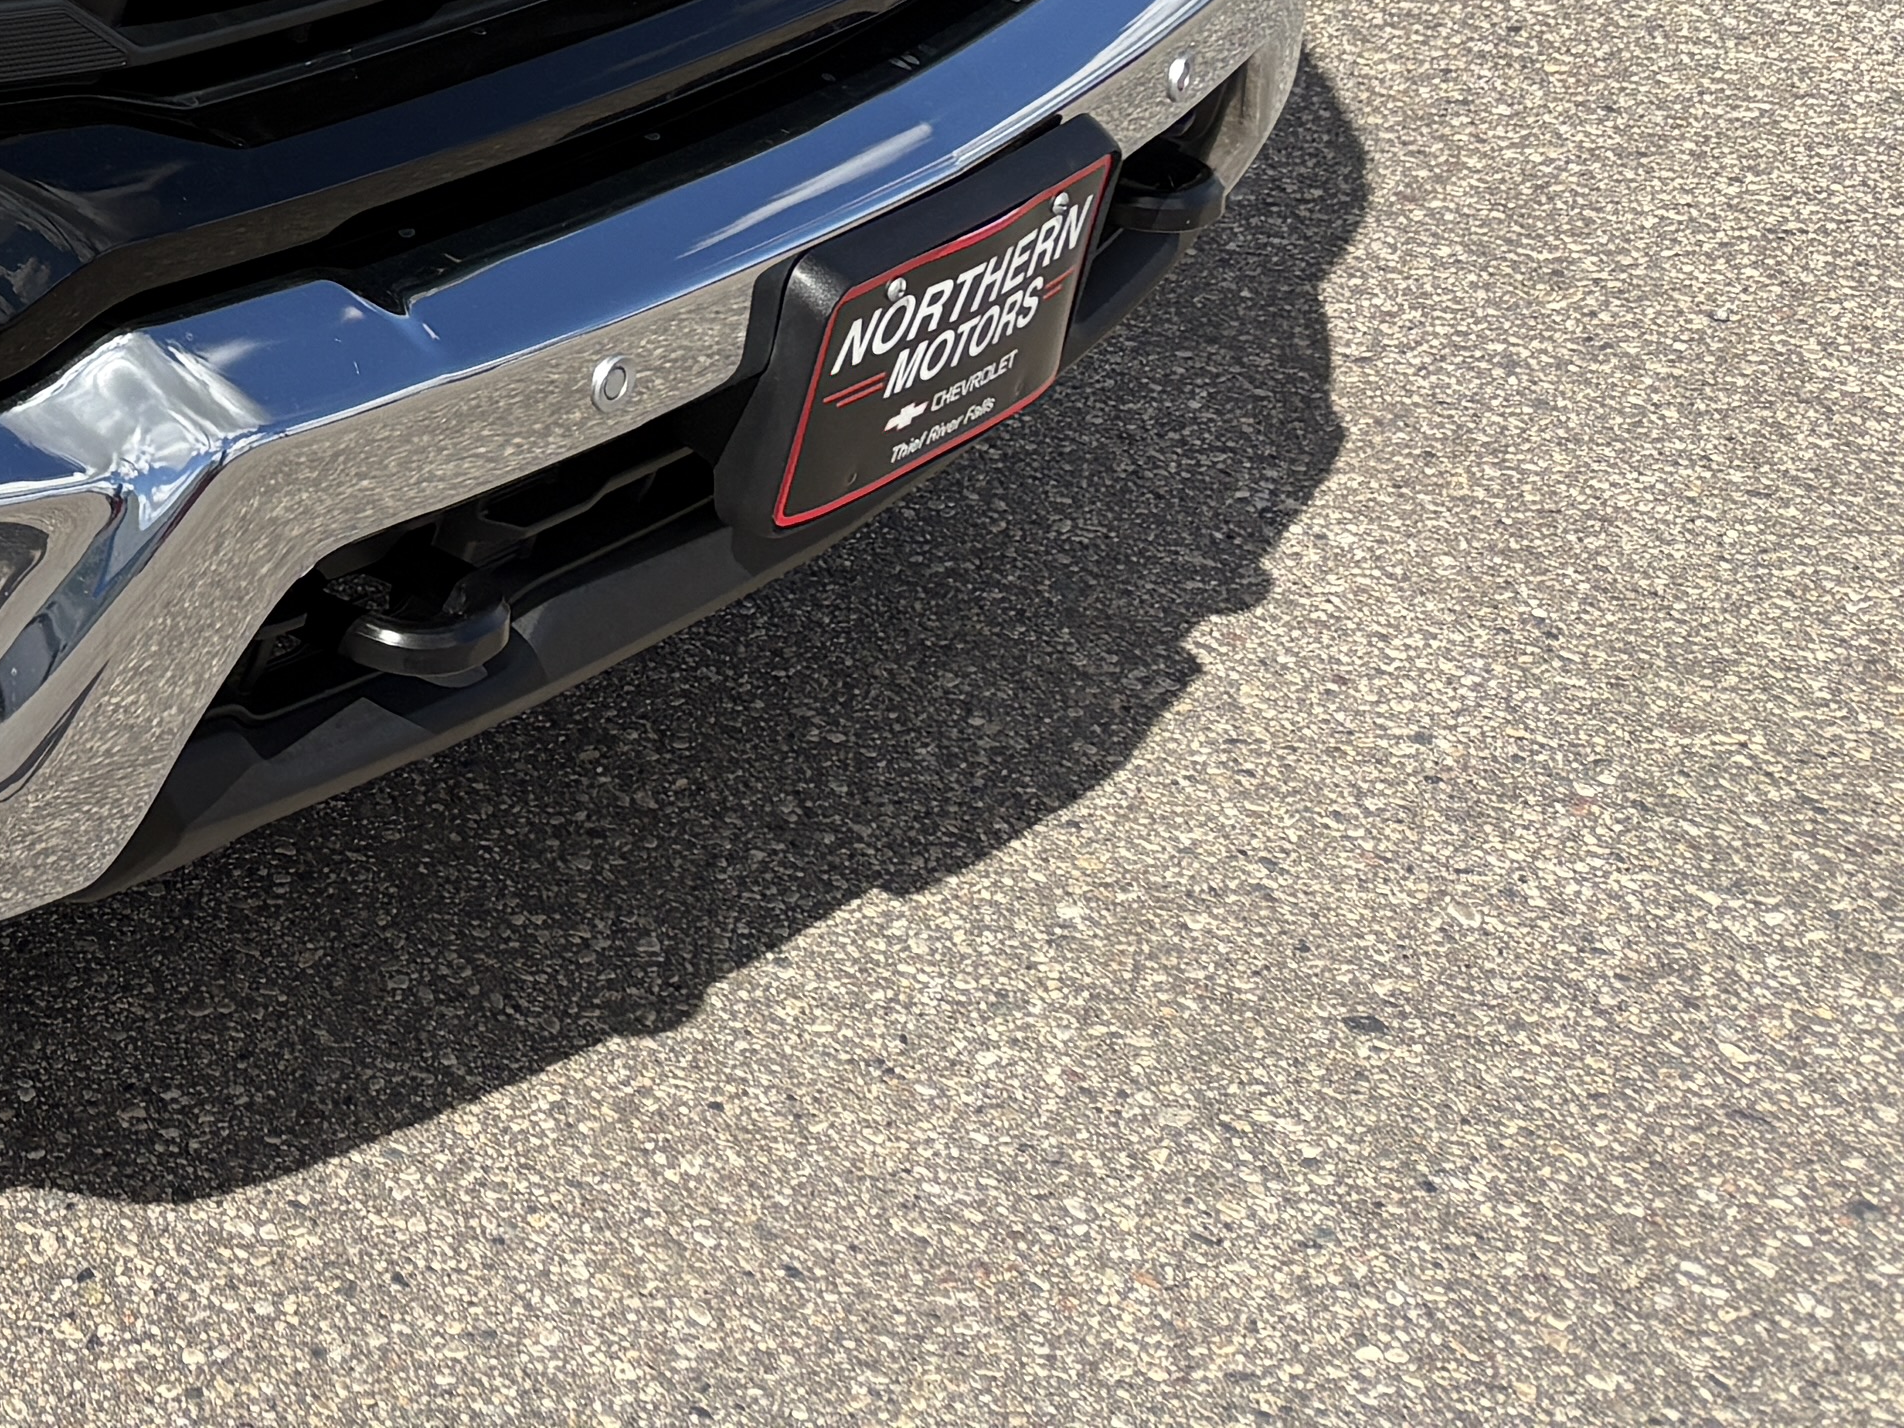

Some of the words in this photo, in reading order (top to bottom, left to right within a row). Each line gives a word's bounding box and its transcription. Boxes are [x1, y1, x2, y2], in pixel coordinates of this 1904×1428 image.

[829, 193, 1094, 376] NORTHERN
[882, 276, 1044, 399] MOTORS
[930, 348, 1019, 412] CHEVROLET
[890, 430, 928, 463] Thief
[926, 414, 964, 445] River
